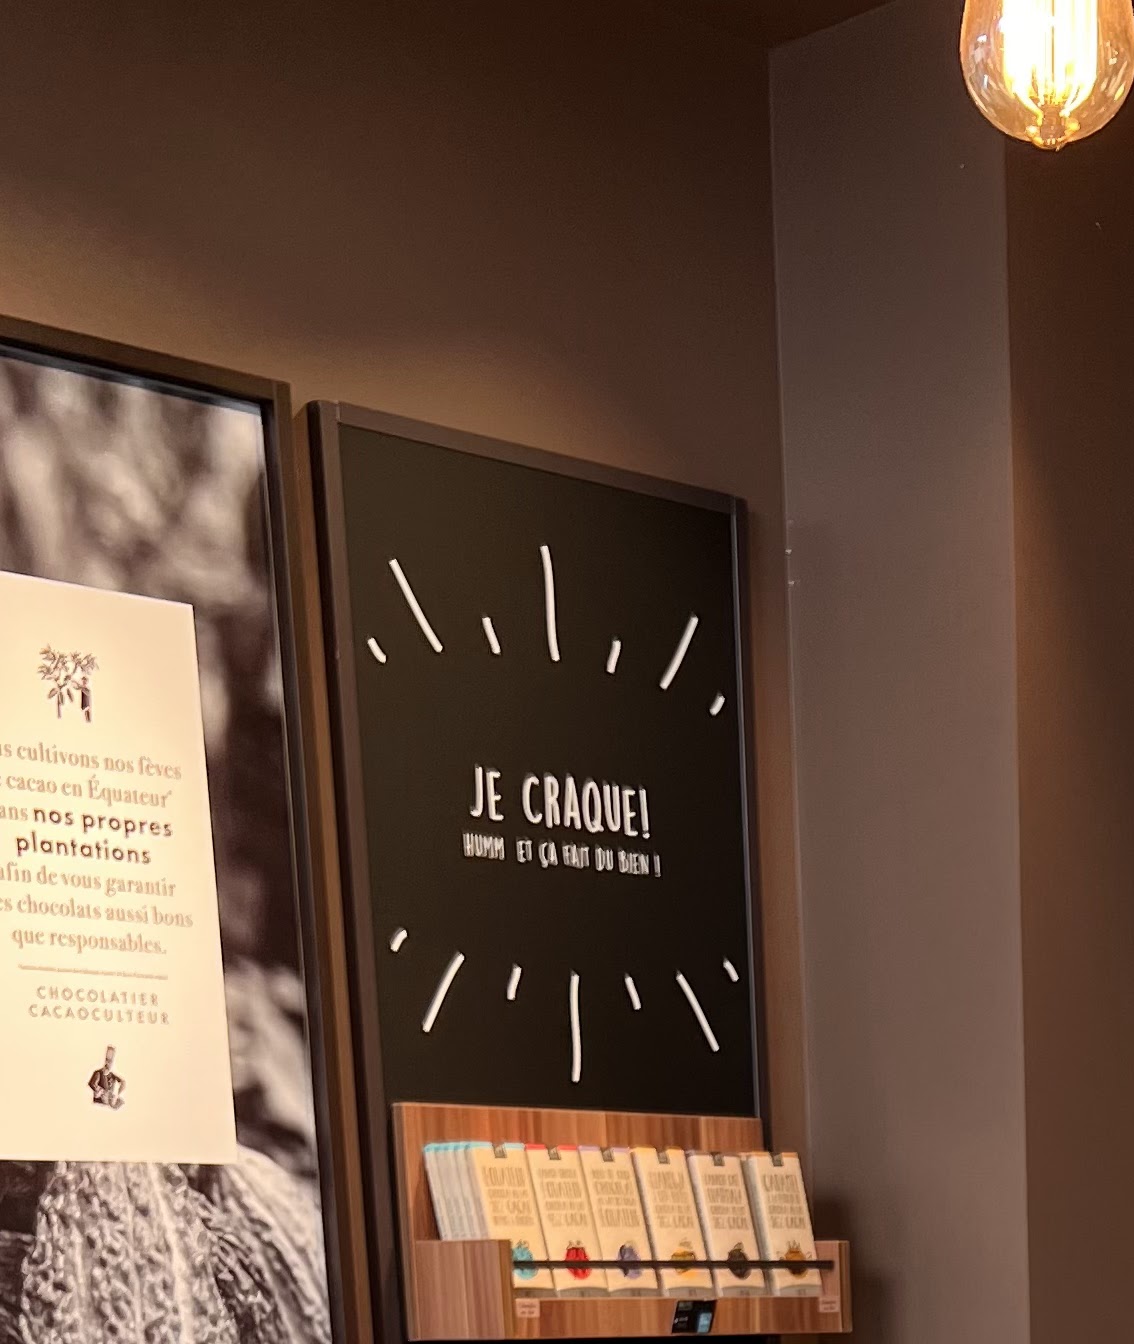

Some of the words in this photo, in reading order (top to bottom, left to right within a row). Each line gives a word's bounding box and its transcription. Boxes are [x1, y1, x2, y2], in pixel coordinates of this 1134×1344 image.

[17, 742, 100, 769] cultivons
[104, 756, 134, 774] nos
[139, 755, 181, 780] fèves
[6, 775, 57, 794] cacao
[61, 782, 82, 798] en
[470, 763, 504, 821] JE
[521, 772, 650, 839] CRAQUE!
[33, 807, 74, 825] nos
[82, 813, 173, 838] propres
[16, 829, 152, 864] plantations
[462, 830, 505, 860] HUMM
[516, 837, 533, 864] ET
[538, 839, 559, 869] ÇA
[562, 842, 590, 870] FAIT
[594, 844, 614, 871] DU
[618, 846, 650, 875] BIEN
[36, 865, 58, 885] de
[60, 873, 102, 889] vous
[105, 878, 176, 897] garantir
[17, 894, 101, 919] chocolats
[105, 905, 149, 924] aussi
[151, 906, 193, 928] bons
[12, 929, 45, 949] que
[50, 932, 167, 954] responsables.
[36, 985, 159, 1006] CHOCOLATIER
[28, 1004, 170, 1025] CACAOCULTEUR
